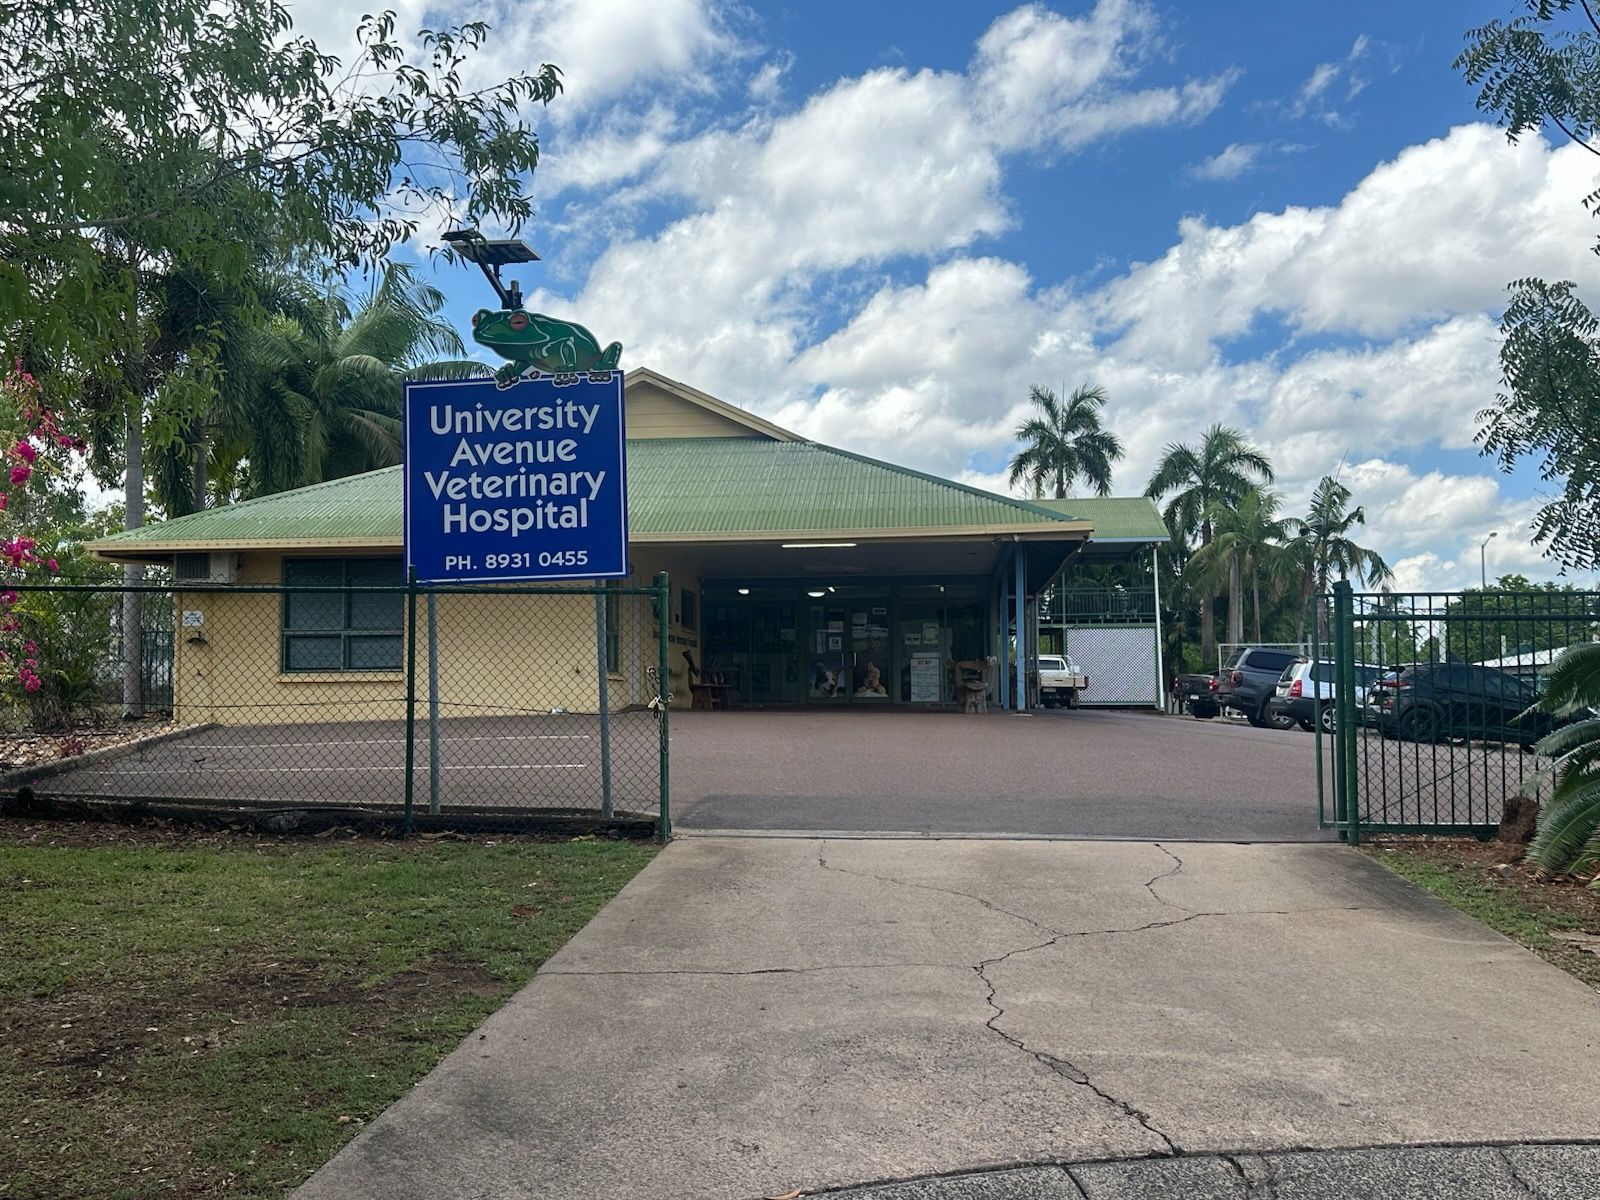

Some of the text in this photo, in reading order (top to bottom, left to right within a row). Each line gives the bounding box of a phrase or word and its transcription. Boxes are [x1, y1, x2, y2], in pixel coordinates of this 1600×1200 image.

[430, 398, 600, 435] University
[449, 437, 578, 467] Avenue
[423, 466, 606, 501] Veterinary
[443, 498, 588, 537] Hospital
[445, 550, 589, 571] PH. 8931 0455
